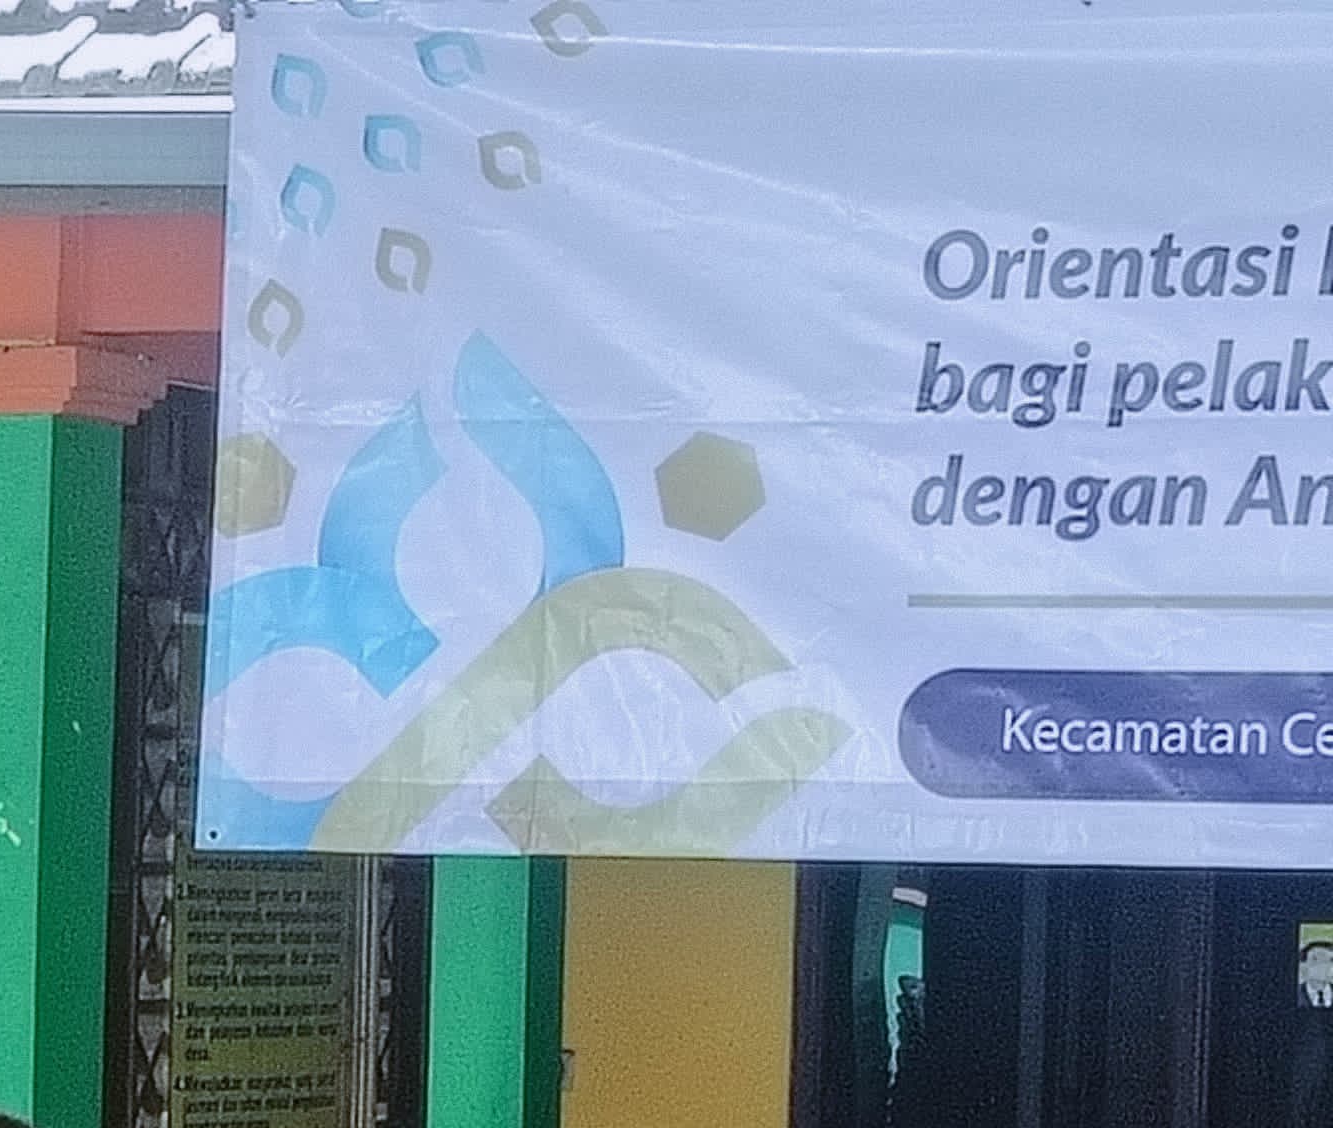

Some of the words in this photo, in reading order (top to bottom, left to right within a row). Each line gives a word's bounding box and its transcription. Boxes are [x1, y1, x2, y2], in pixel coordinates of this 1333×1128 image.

[922, 223, 1300, 300] Orientasi
[914, 340, 1092, 428] bagi
[1105, 337, 1333, 428] pelak
[910, 454, 1207, 541] dengan
[1223, 455, 1333, 526] An
[1000, 707, 1268, 756] Kecamatan
[1282, 710, 1333, 757] Ce
